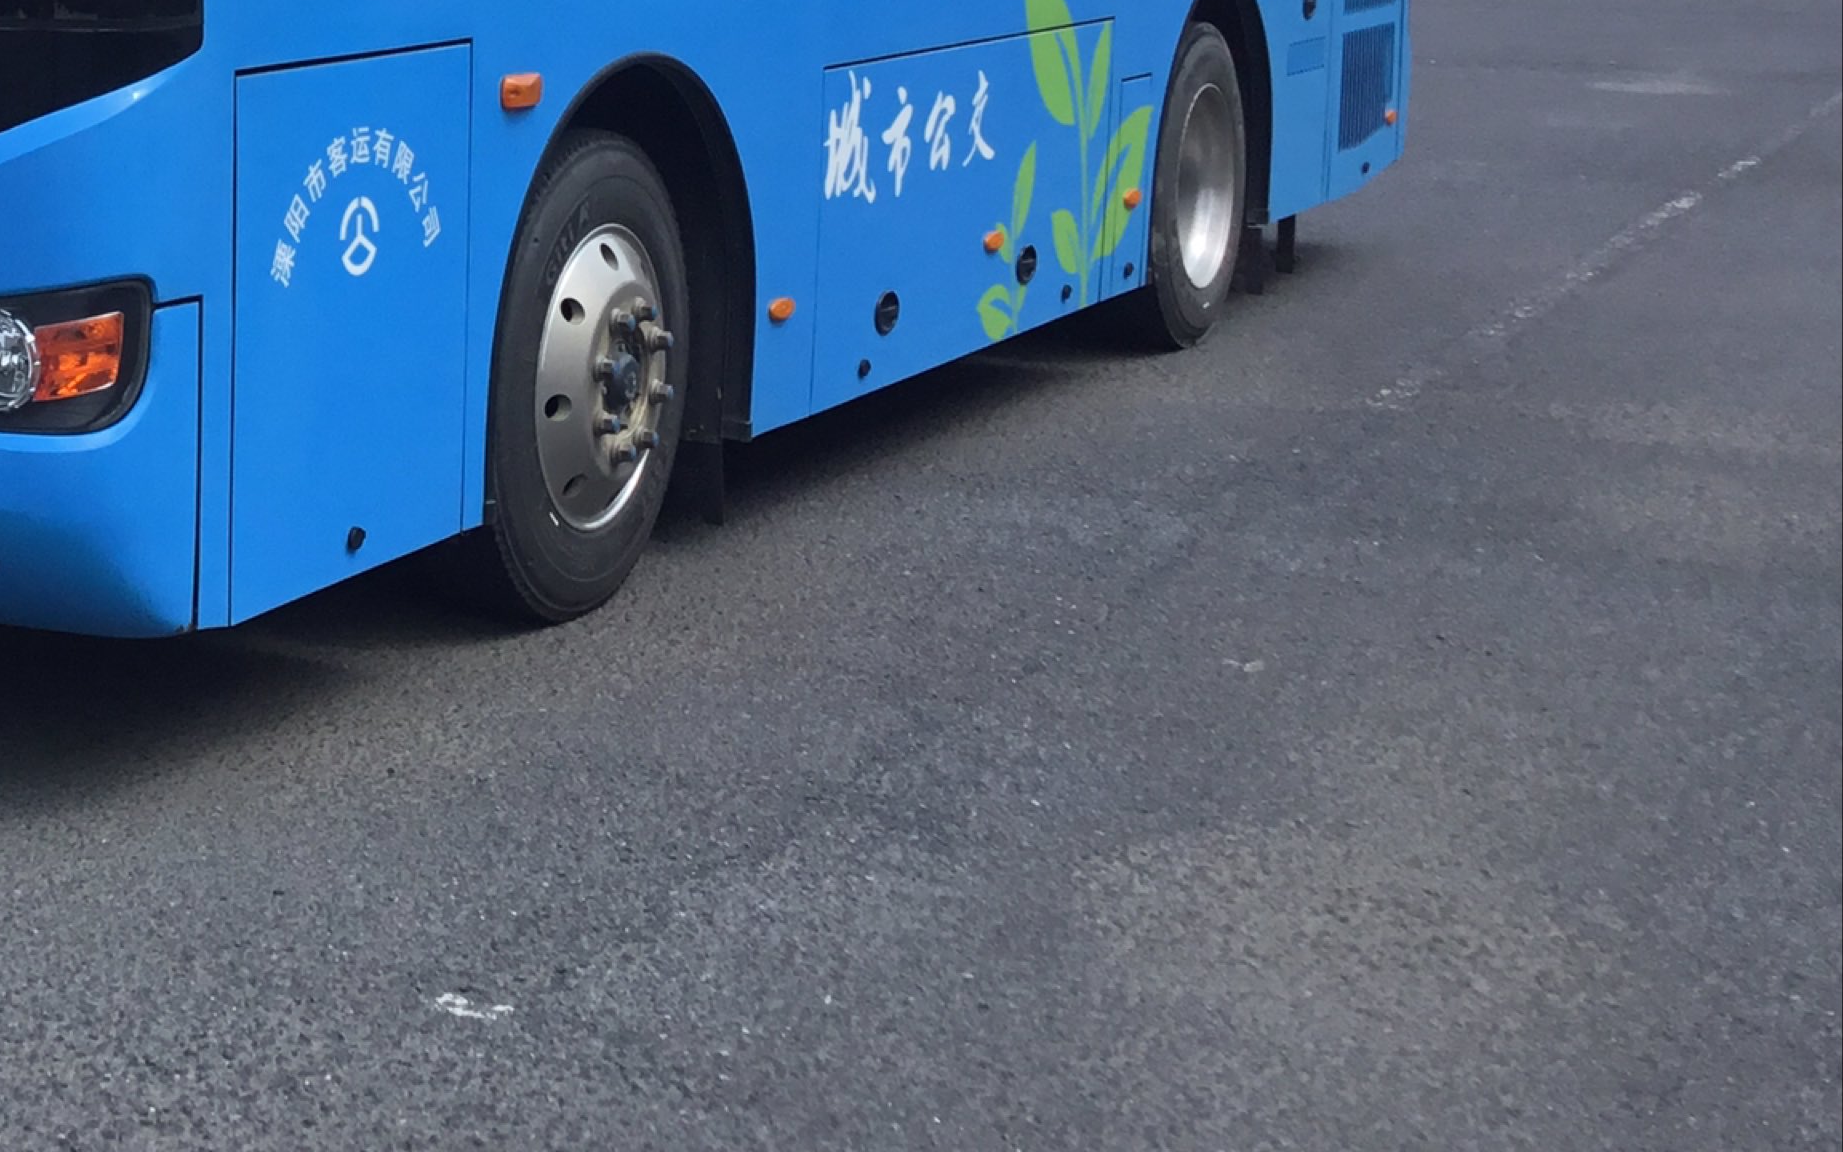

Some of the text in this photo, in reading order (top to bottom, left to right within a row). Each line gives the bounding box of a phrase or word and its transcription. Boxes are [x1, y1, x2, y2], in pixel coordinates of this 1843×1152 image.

[270, 126, 442, 288] 溧阳市客运有限公司
[823, 69, 996, 204] 城市公交
